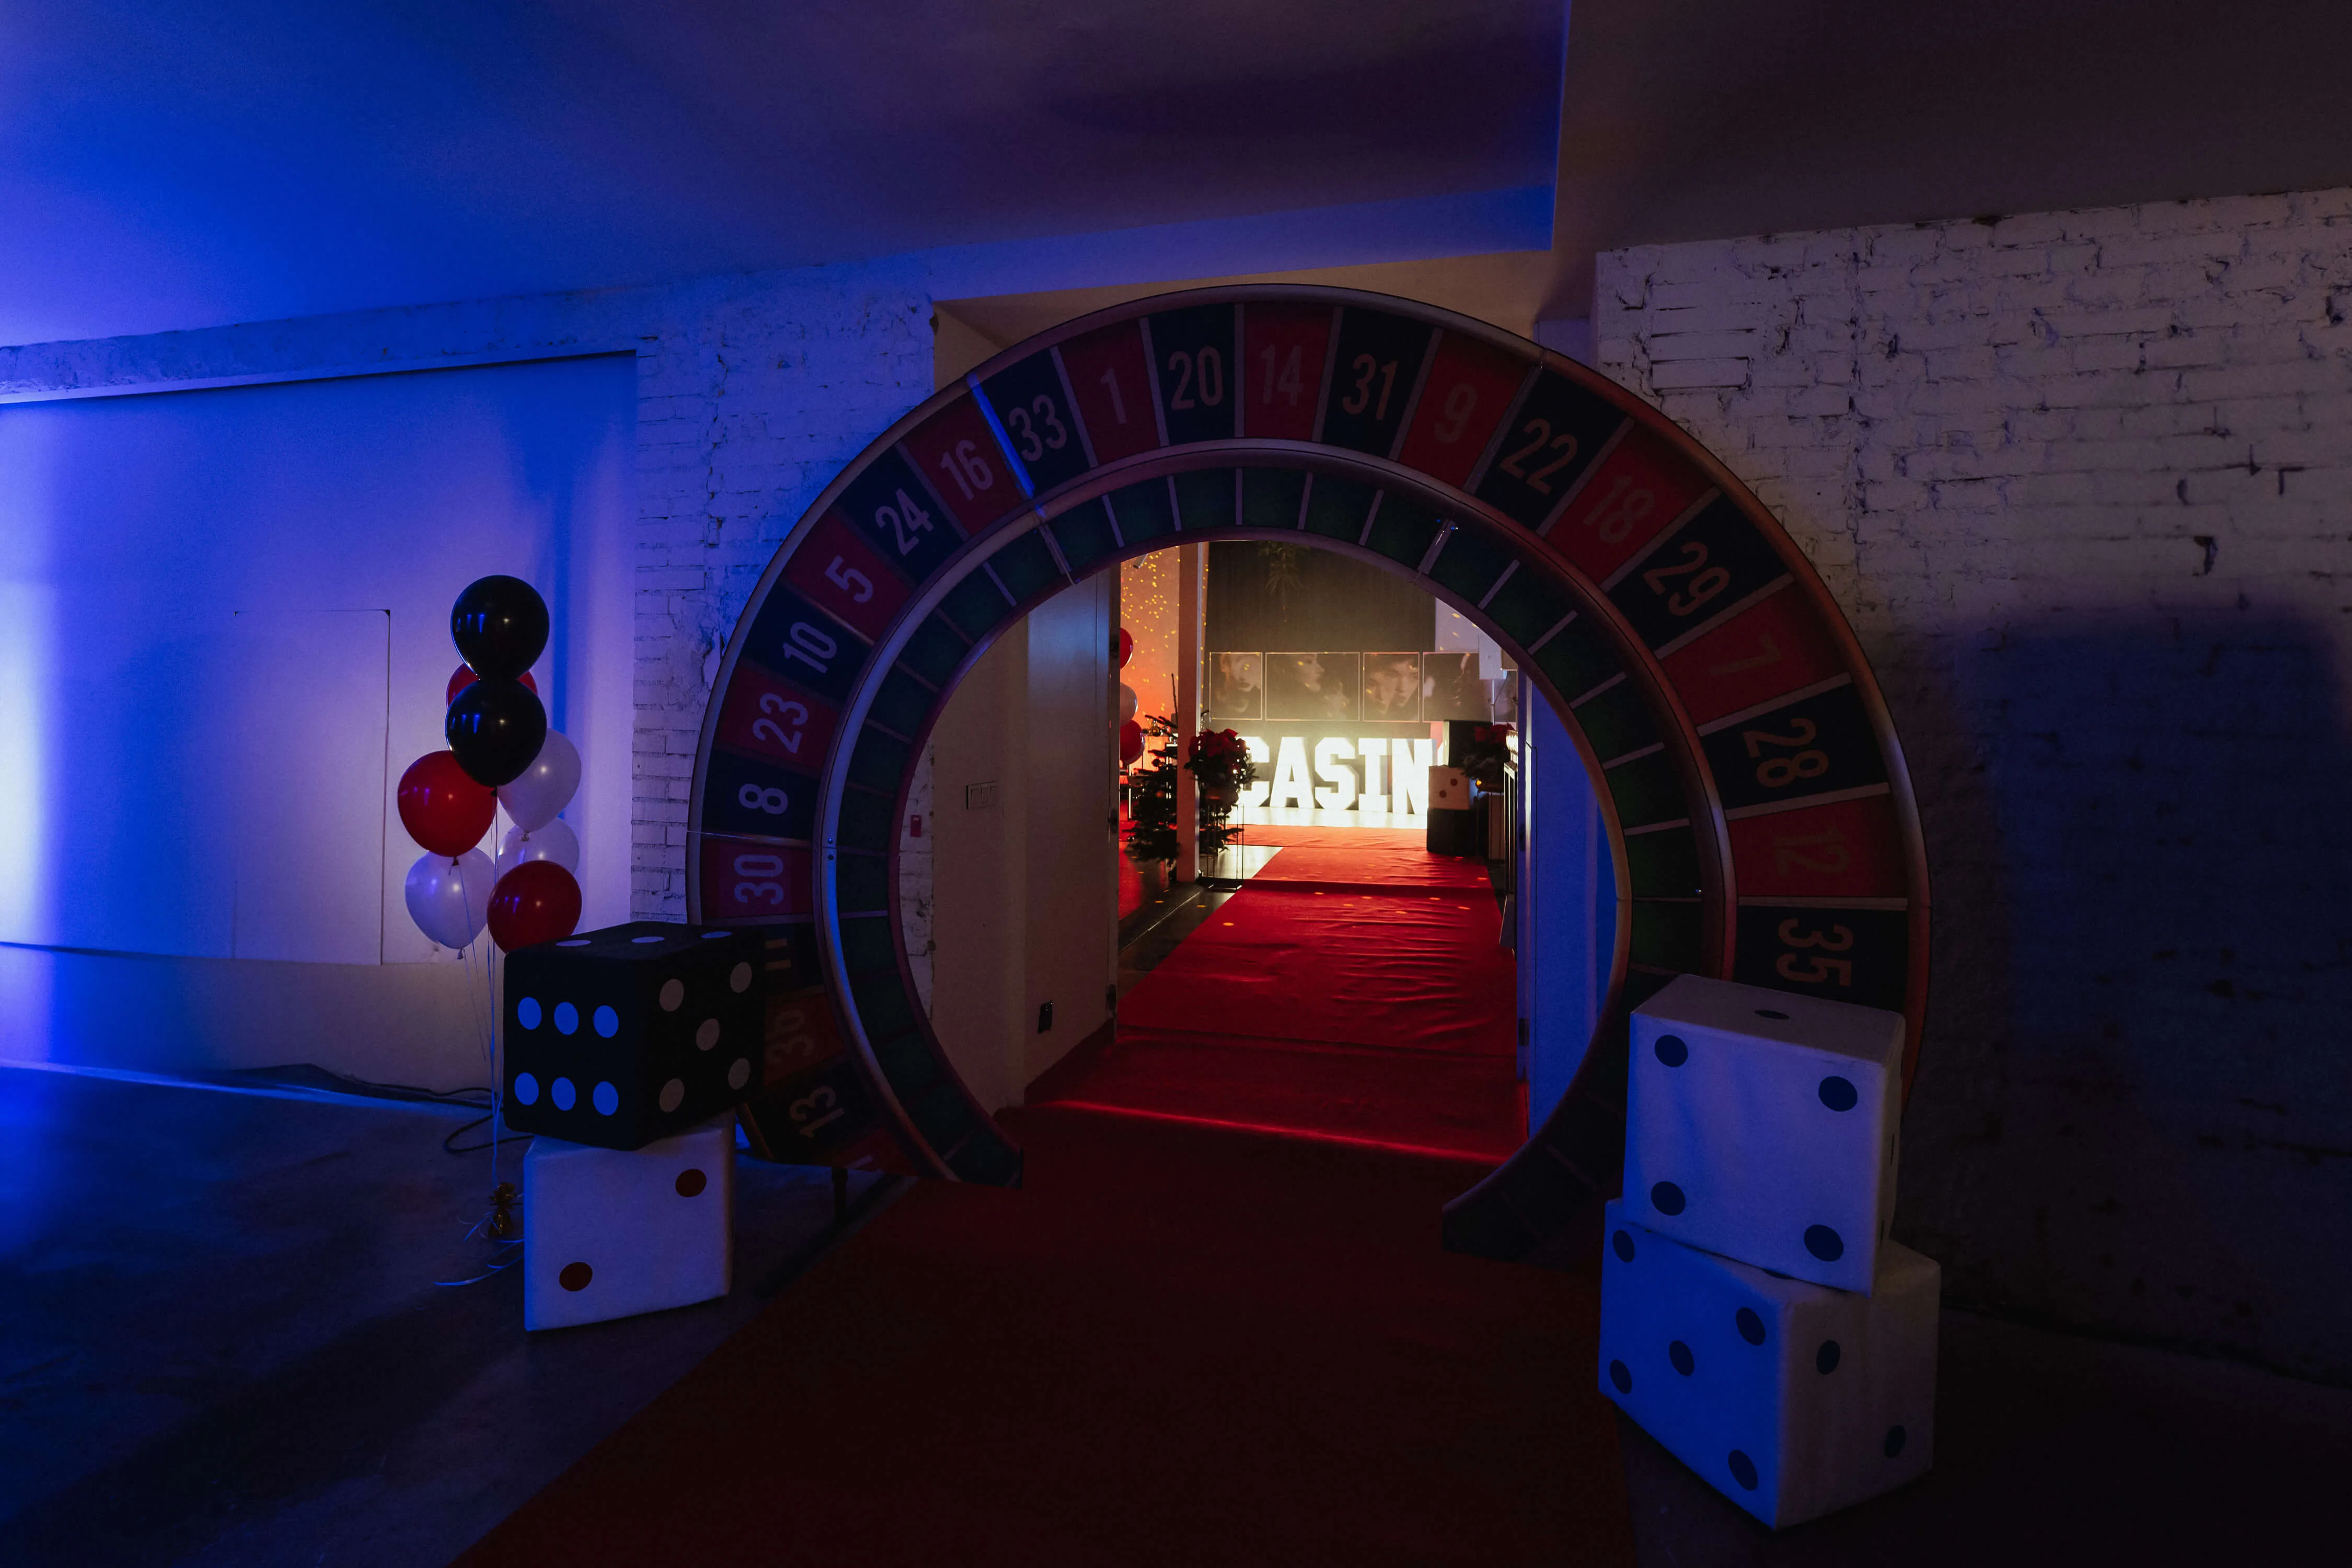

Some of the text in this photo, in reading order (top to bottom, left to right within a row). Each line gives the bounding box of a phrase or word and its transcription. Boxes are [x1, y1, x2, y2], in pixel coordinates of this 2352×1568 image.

[1101, 368, 1126, 424] 1
[1168, 346, 1223, 411] 20
[1261, 344, 1304, 405] 14
[1342, 353, 1399, 420] 31
[1008, 394, 1067, 462] 33
[1434, 383, 1478, 444] 9
[941, 440, 993, 500] 16
[1498, 419, 1578, 495] 22
[874, 488, 934, 556] 24
[1583, 475, 1654, 543] 18
[824, 555, 873, 603] 5
[1643, 541, 1730, 616] 29
[782, 622, 837, 673] 10
[1711, 632, 1783, 676] 7
[753, 693, 809, 753] 23
[1743, 718, 1829, 788] 28
[739, 783, 788, 814] 8
[1235, 736, 1444, 815] CASIN
[734, 855, 784, 905] 30
[1772, 826, 1850, 876] 12
[1777, 918, 1854, 987] 35
[789, 1086, 845, 1139] 13
